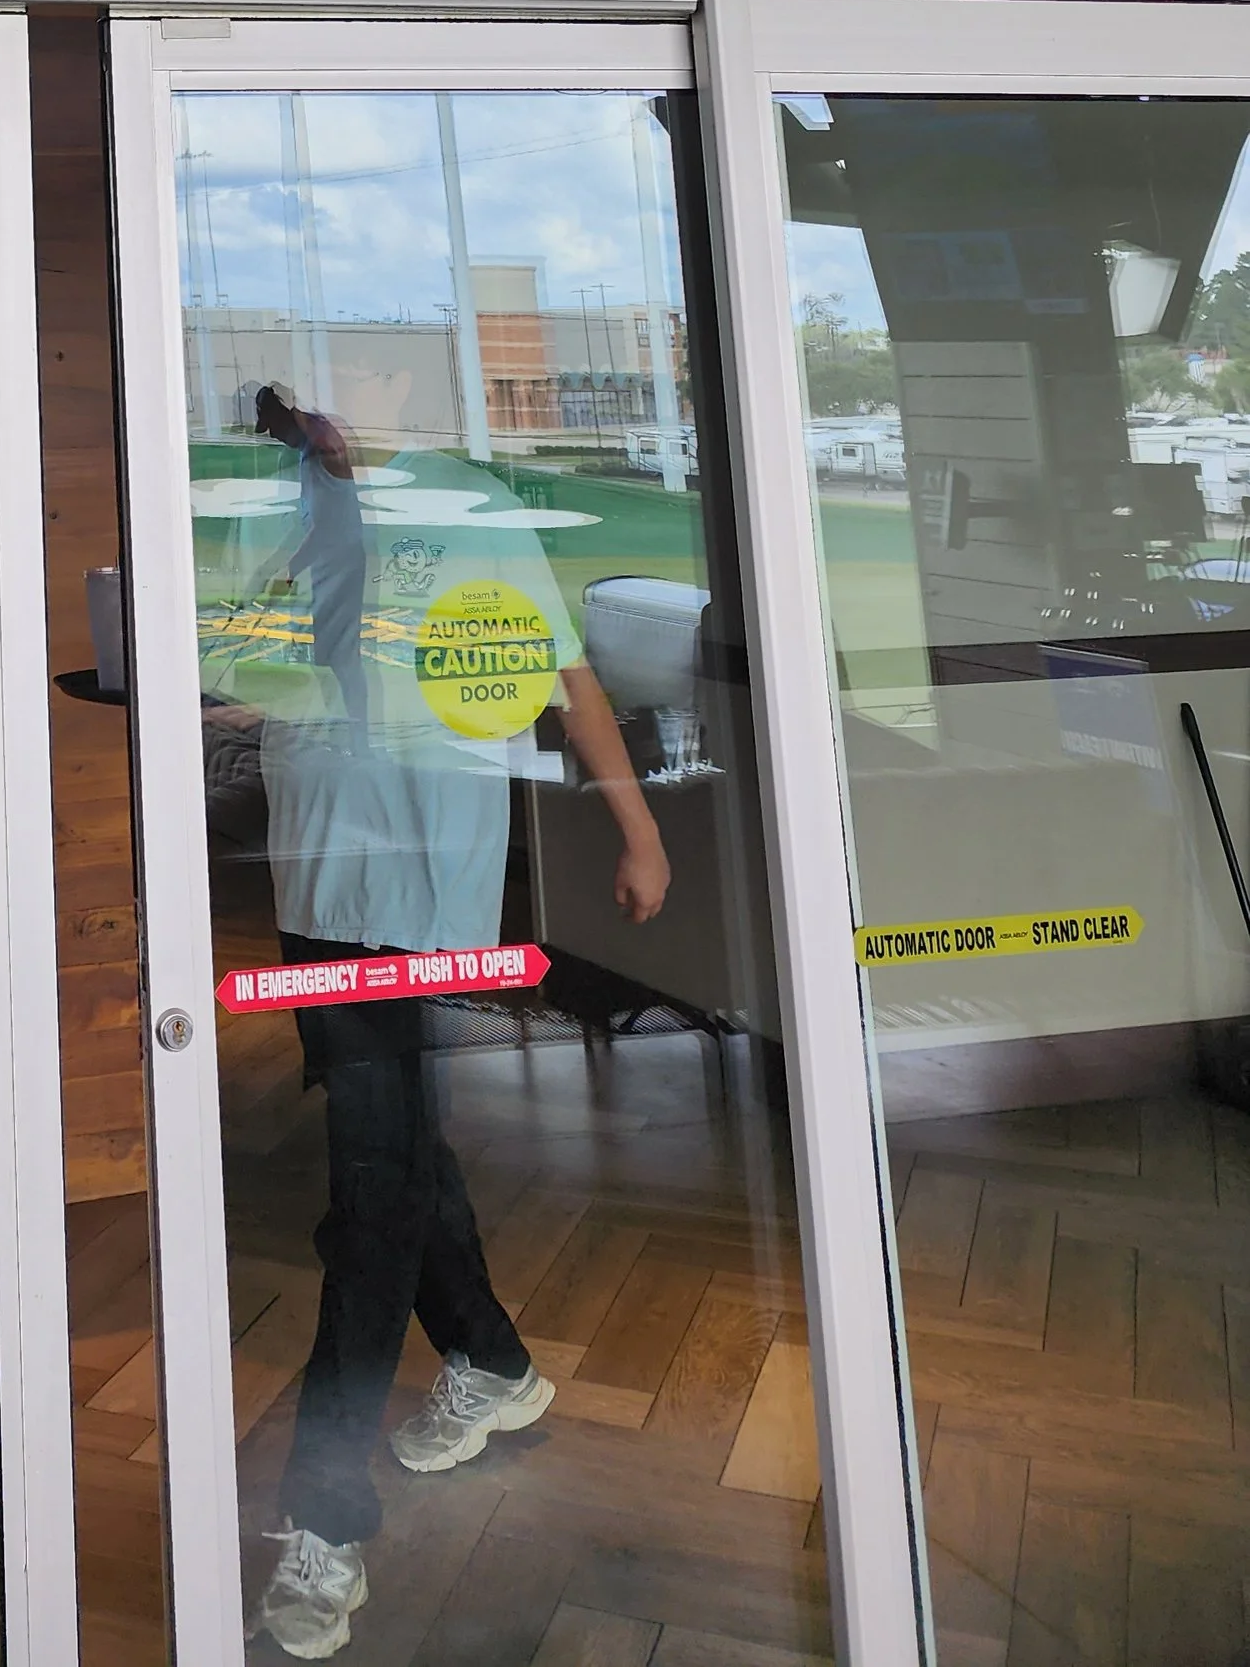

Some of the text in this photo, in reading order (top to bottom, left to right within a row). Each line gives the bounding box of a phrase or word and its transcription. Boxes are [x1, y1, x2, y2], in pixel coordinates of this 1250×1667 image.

[461, 591, 490, 601] besam
[429, 616, 541, 639] AUTOMATIC
[424, 643, 549, 678] CAUTION
[461, 682, 519, 703] DOOR
[865, 926, 996, 960] AUTOMATIC DOOR
[1032, 915, 1130, 945] STAND CLEAR
[235, 963, 359, 1002] IN EMERGENCY
[408, 948, 526, 985] PUSH TO OPEN
